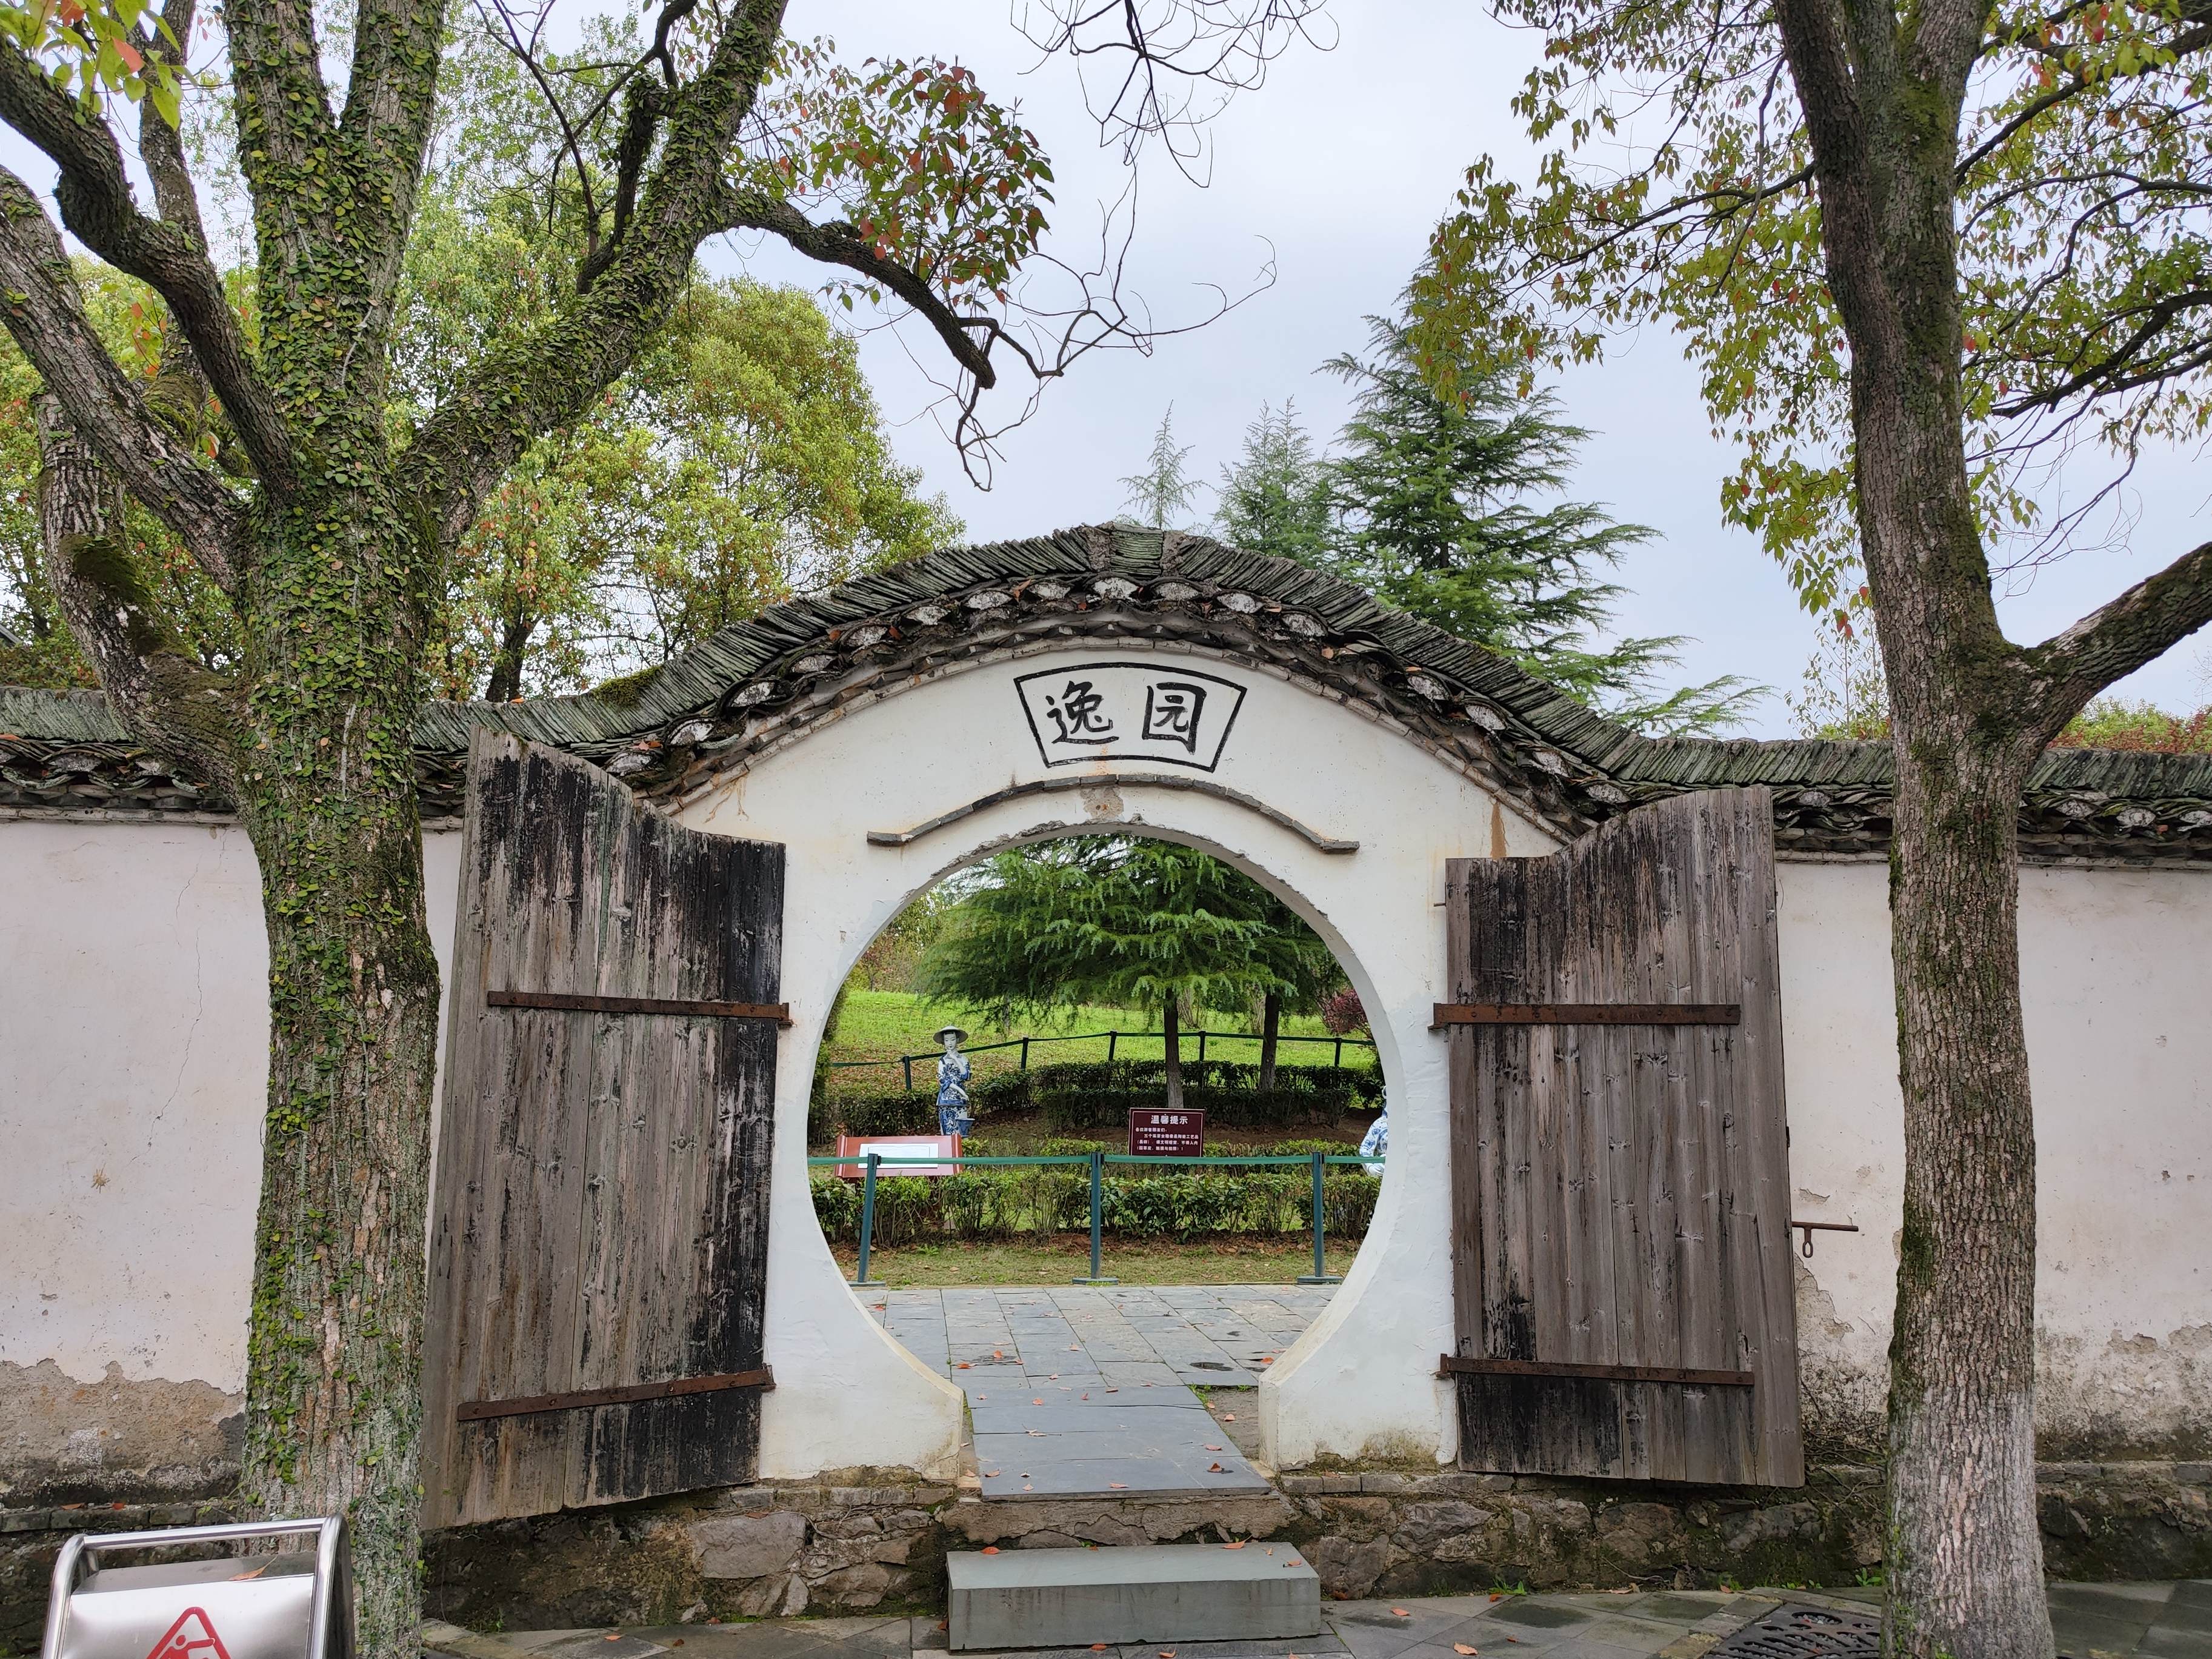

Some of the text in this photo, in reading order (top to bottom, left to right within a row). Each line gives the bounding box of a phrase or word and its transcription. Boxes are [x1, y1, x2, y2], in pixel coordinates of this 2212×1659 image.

[1045, 680, 1207, 755] 逸园
[1150, 1115, 1188, 1124] 温馨提示
